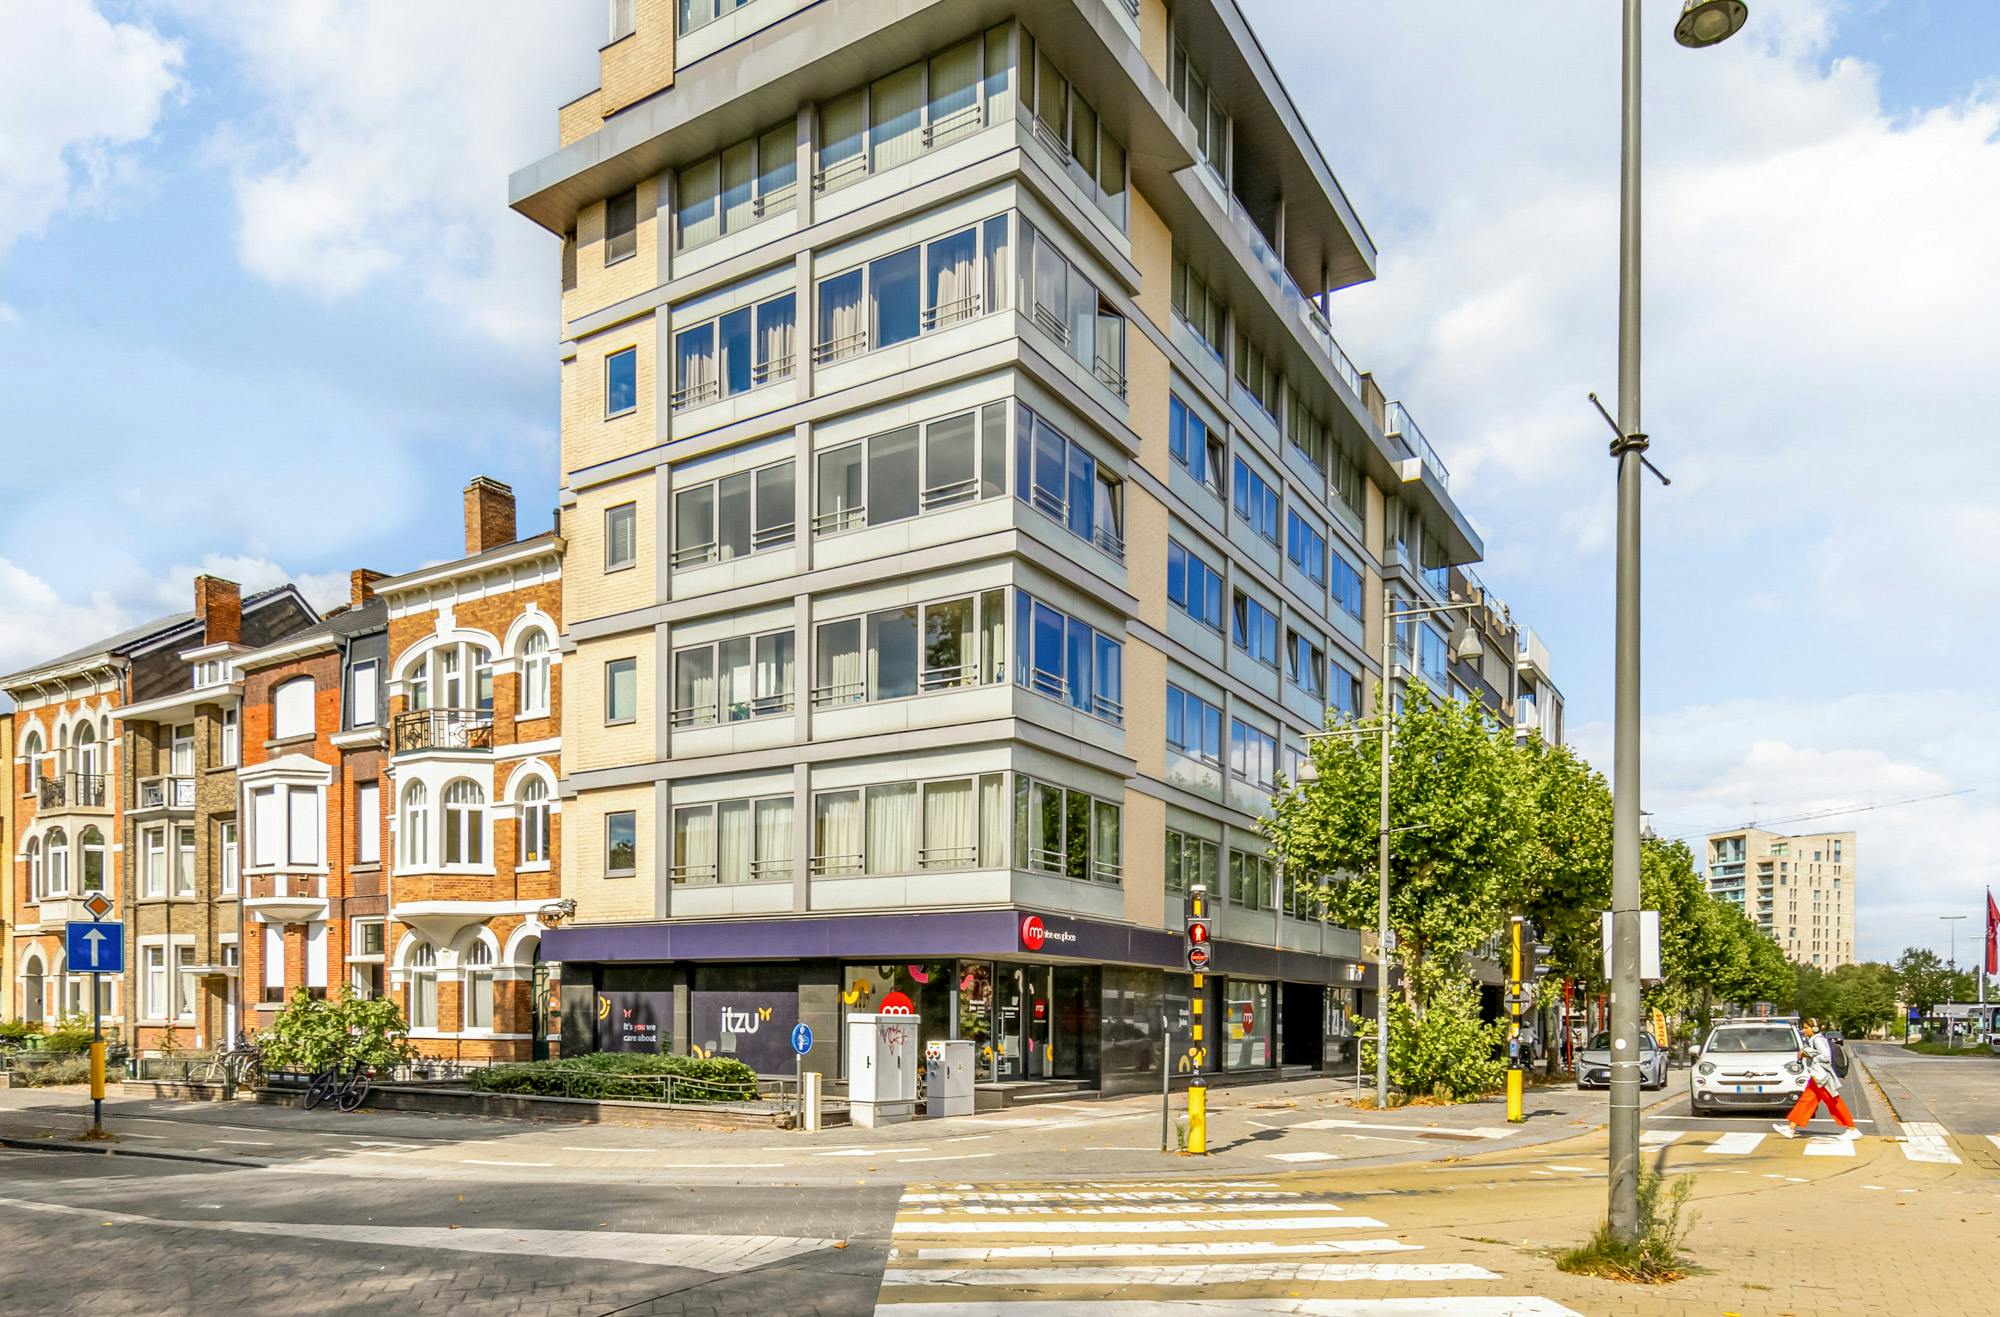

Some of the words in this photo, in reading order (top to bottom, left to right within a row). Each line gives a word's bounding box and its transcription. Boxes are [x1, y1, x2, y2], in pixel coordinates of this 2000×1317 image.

[1029, 927, 1043, 939] mp
[721, 1007, 759, 1033] itzu
[1242, 1013, 1253, 1024] mp
[623, 1022, 633, 1031] It's
[633, 1024, 646, 1032] you
[637, 1034, 656, 1042] about
